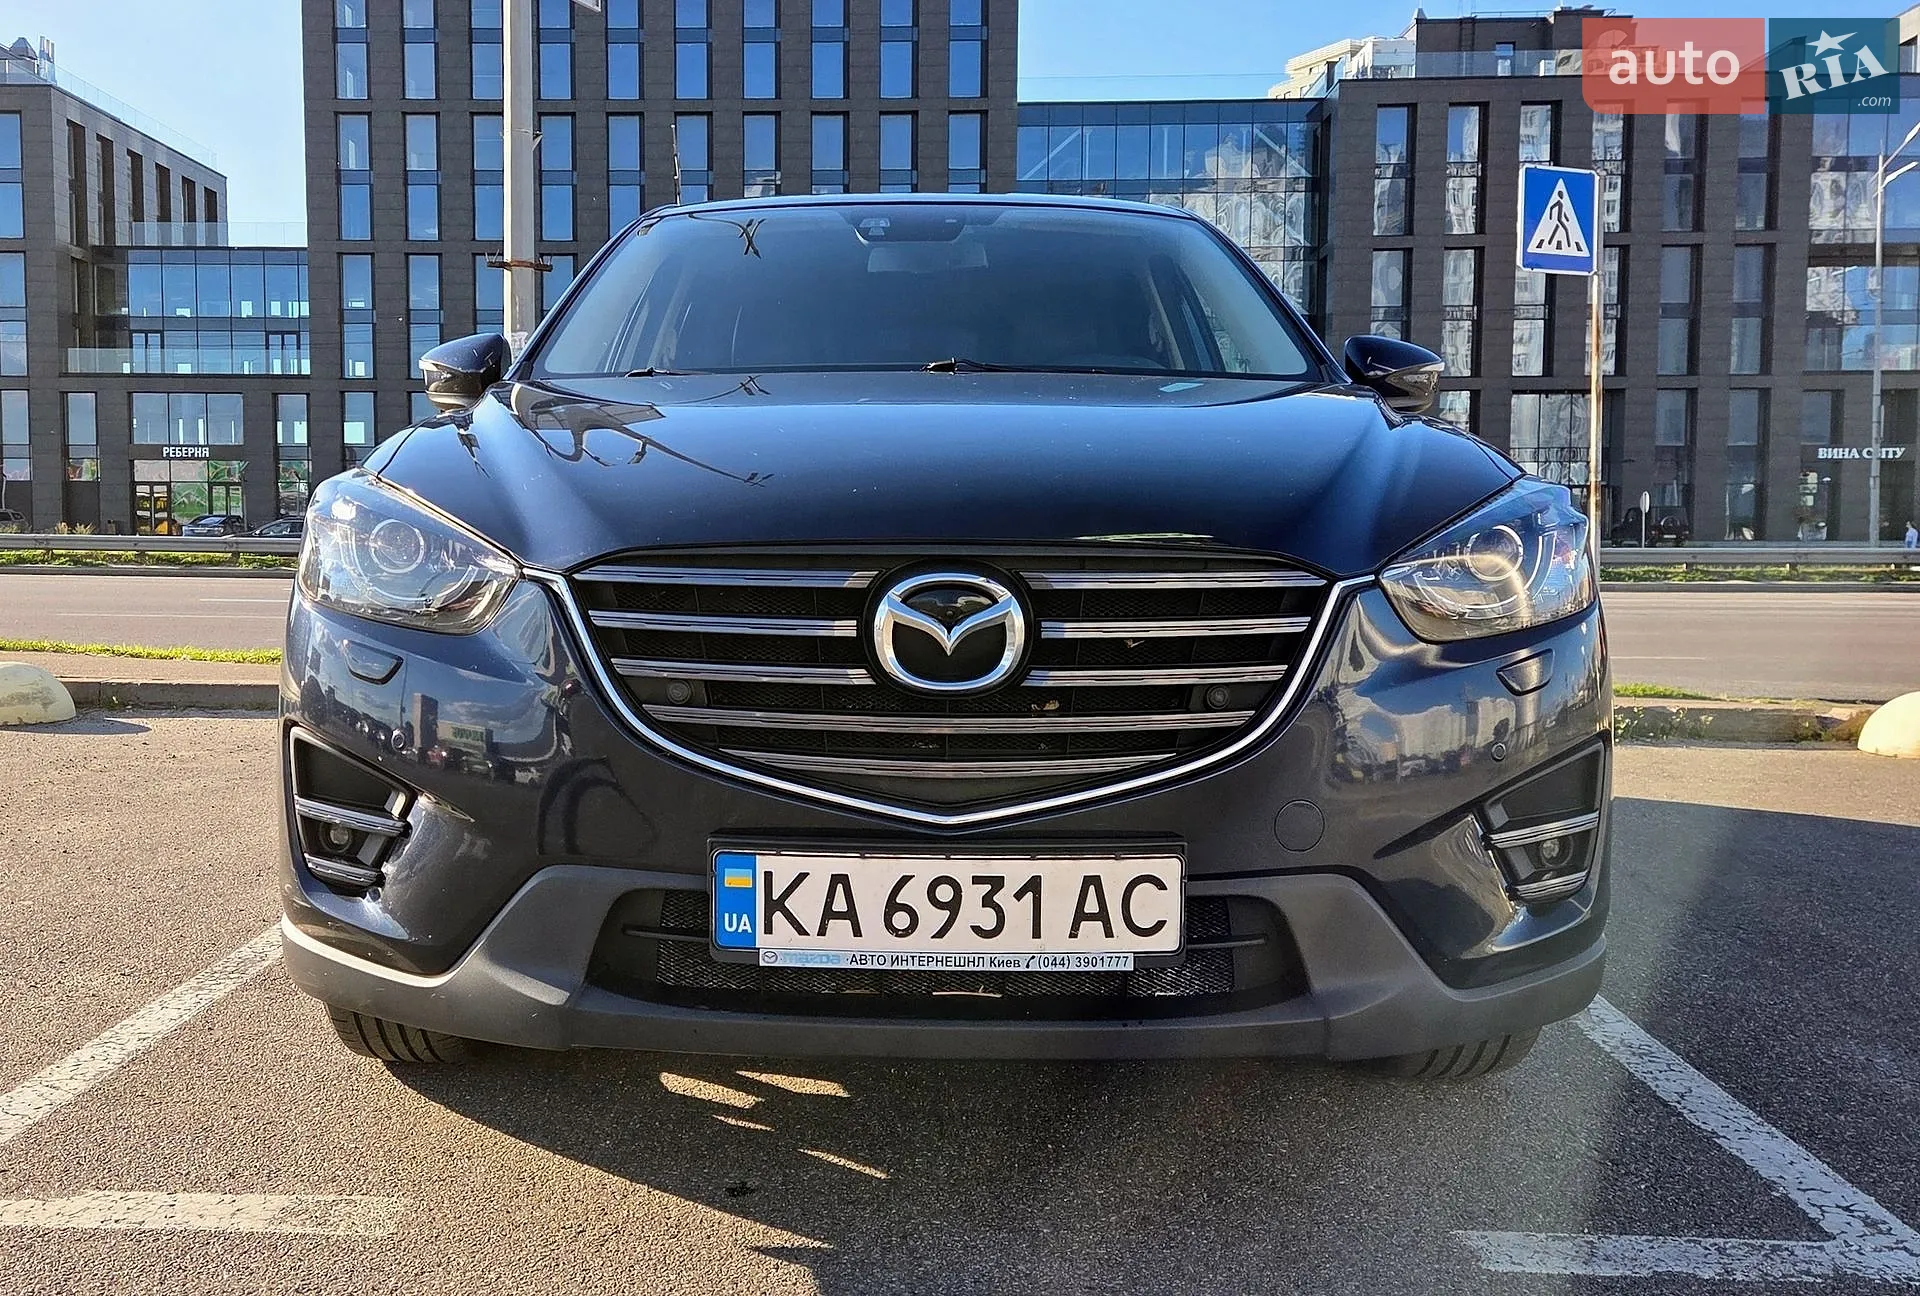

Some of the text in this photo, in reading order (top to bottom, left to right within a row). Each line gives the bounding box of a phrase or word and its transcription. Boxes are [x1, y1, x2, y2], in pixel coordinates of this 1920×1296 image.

[162, 446, 210, 458] РЕБЕРНЯ
[1817, 447, 1906, 459] ВИНА СІТУ
[763, 870, 1168, 940] KA 6931 AC
[724, 913, 752, 934] UA
[849, 953, 1130, 970] АВТО ИНТЕРНЕШНЛ Киев (044) 3901777
